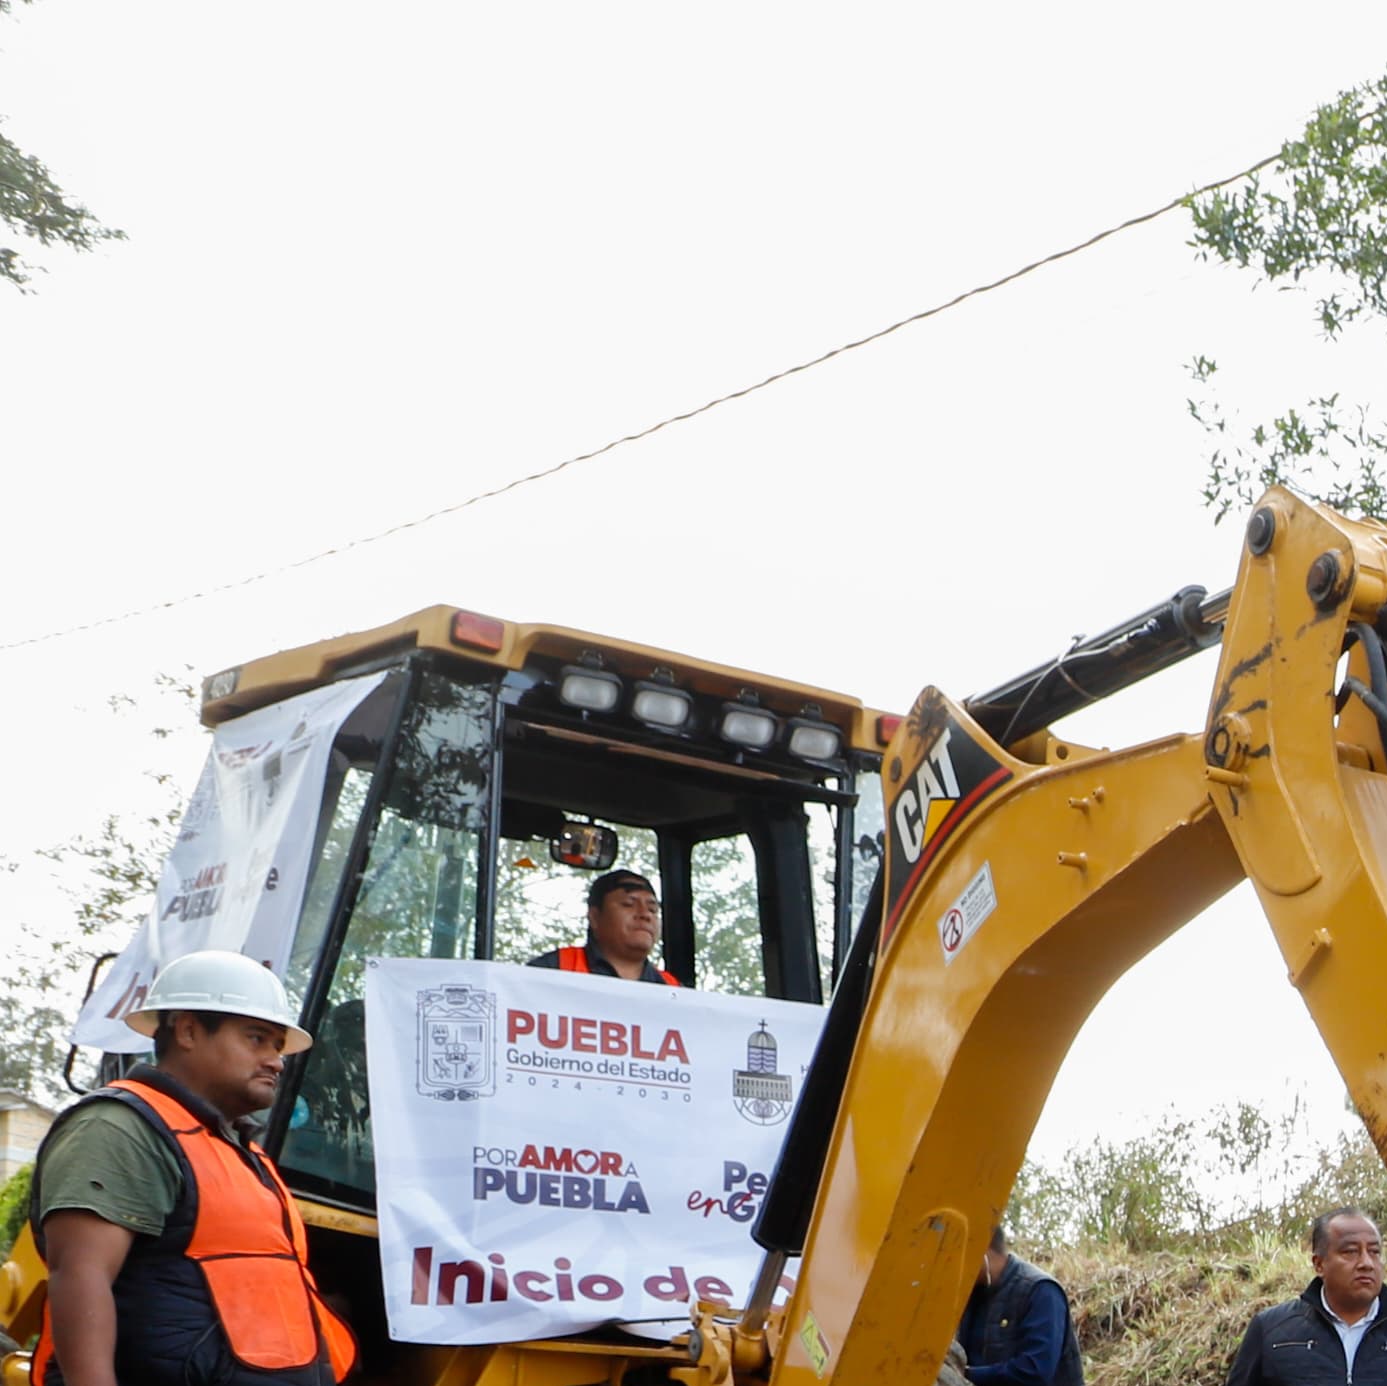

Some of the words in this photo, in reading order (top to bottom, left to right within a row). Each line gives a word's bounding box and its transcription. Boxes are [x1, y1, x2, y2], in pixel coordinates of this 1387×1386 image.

[895, 727, 961, 864] CAT
[506, 1008, 690, 1065] PUEBLA
[507, 1049, 594, 1075] Gobierno
[597, 1059, 625, 1077] del
[629, 1063, 691, 1085] Estado
[473, 1146, 518, 1168] POR
[518, 1144, 623, 1177] AMOR
[624, 1161, 638, 1178] A
[473, 1167, 650, 1215] PUEBLA
[411, 1246, 624, 1307] Inicio
[643, 1266, 735, 1308] de
